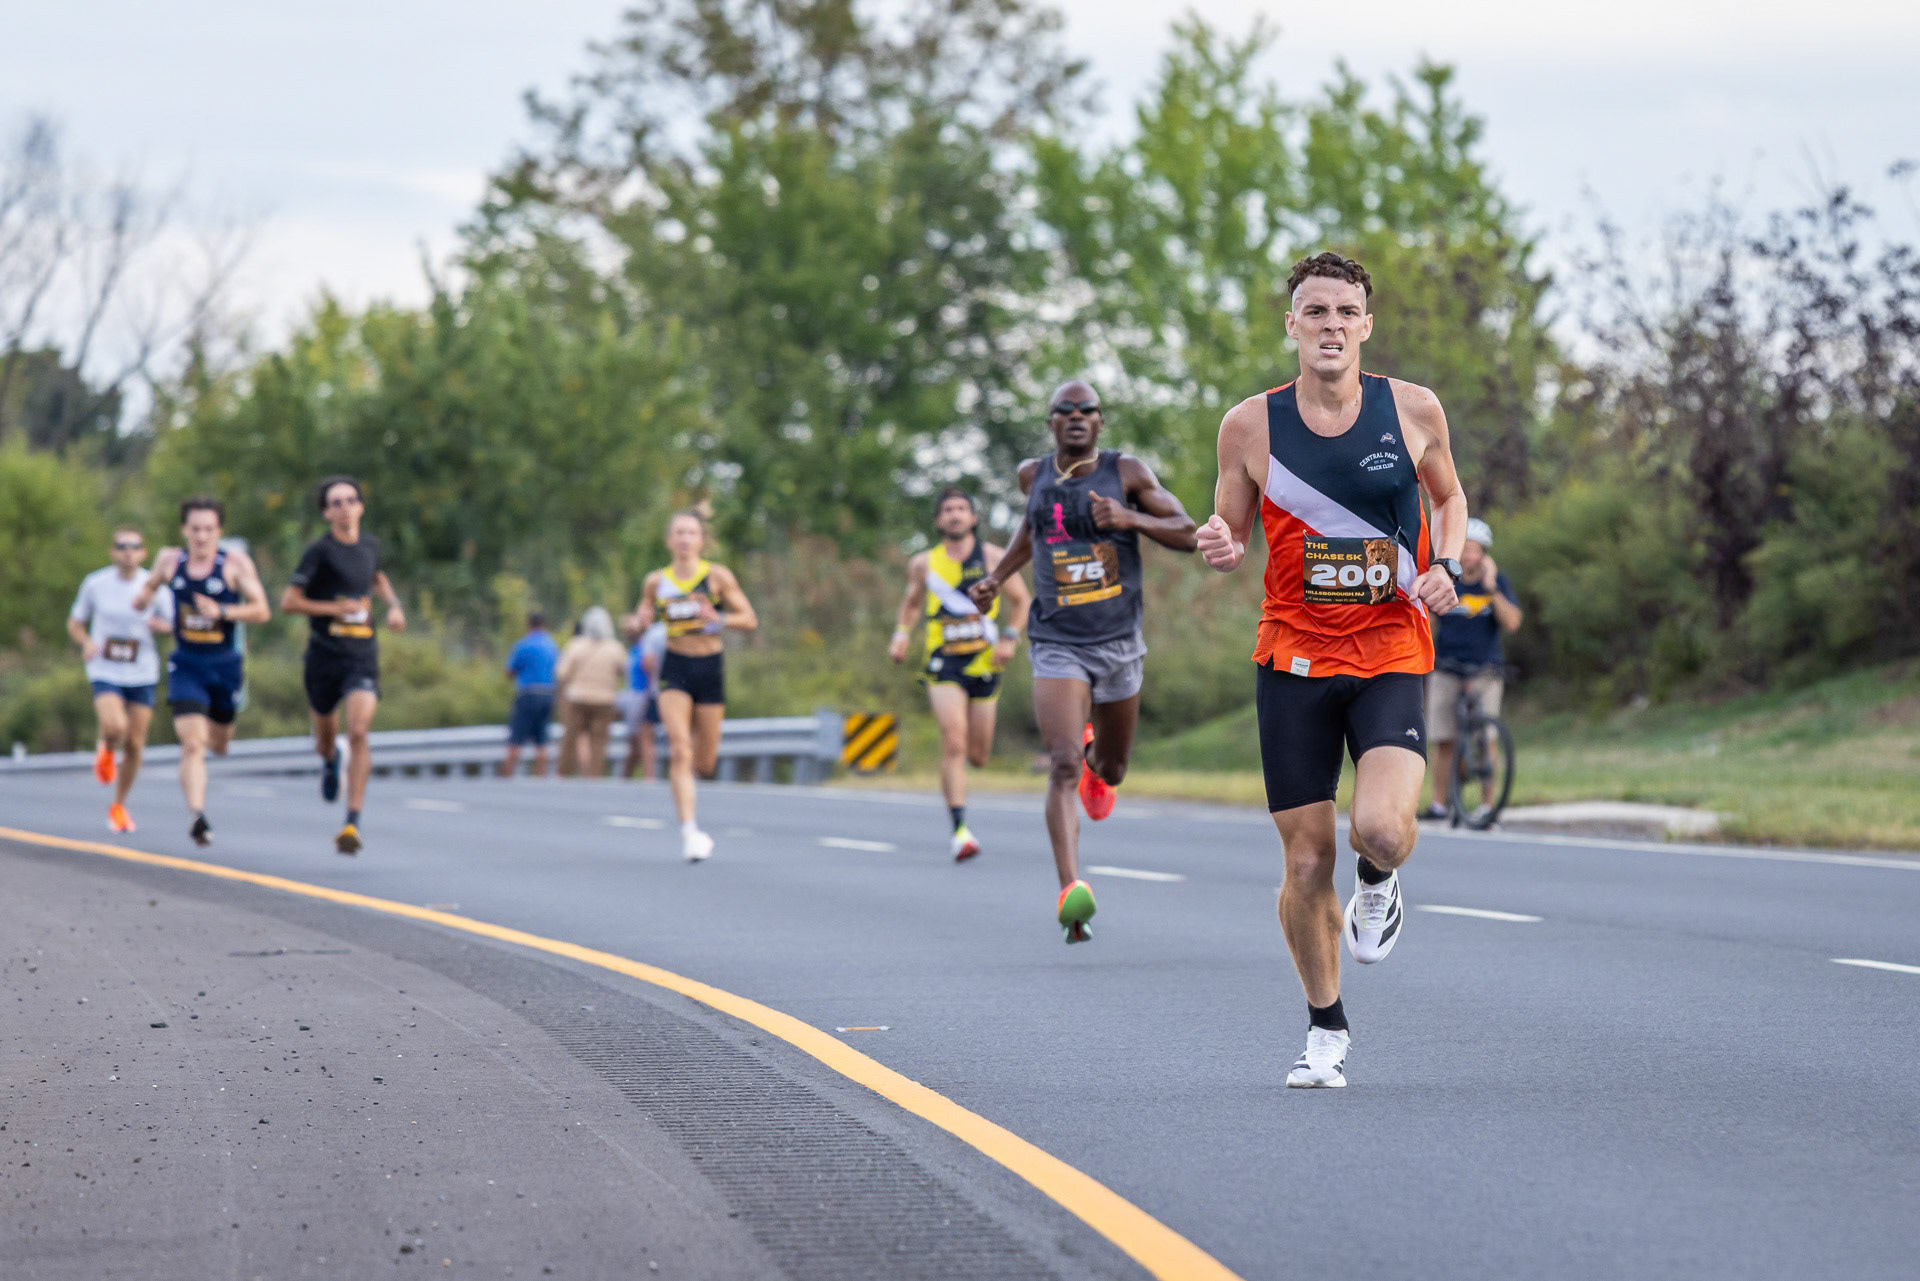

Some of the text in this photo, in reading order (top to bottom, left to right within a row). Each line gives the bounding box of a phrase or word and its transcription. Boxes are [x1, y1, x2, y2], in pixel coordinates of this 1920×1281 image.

[1359, 452, 1383, 467] CENTRAL
[1384, 452, 1399, 461] PARK
[1305, 541, 1328, 550] THE
[1305, 552, 1362, 561] CHASE 5K
[1067, 561, 1105, 582] 75
[1311, 564, 1390, 587] 200
